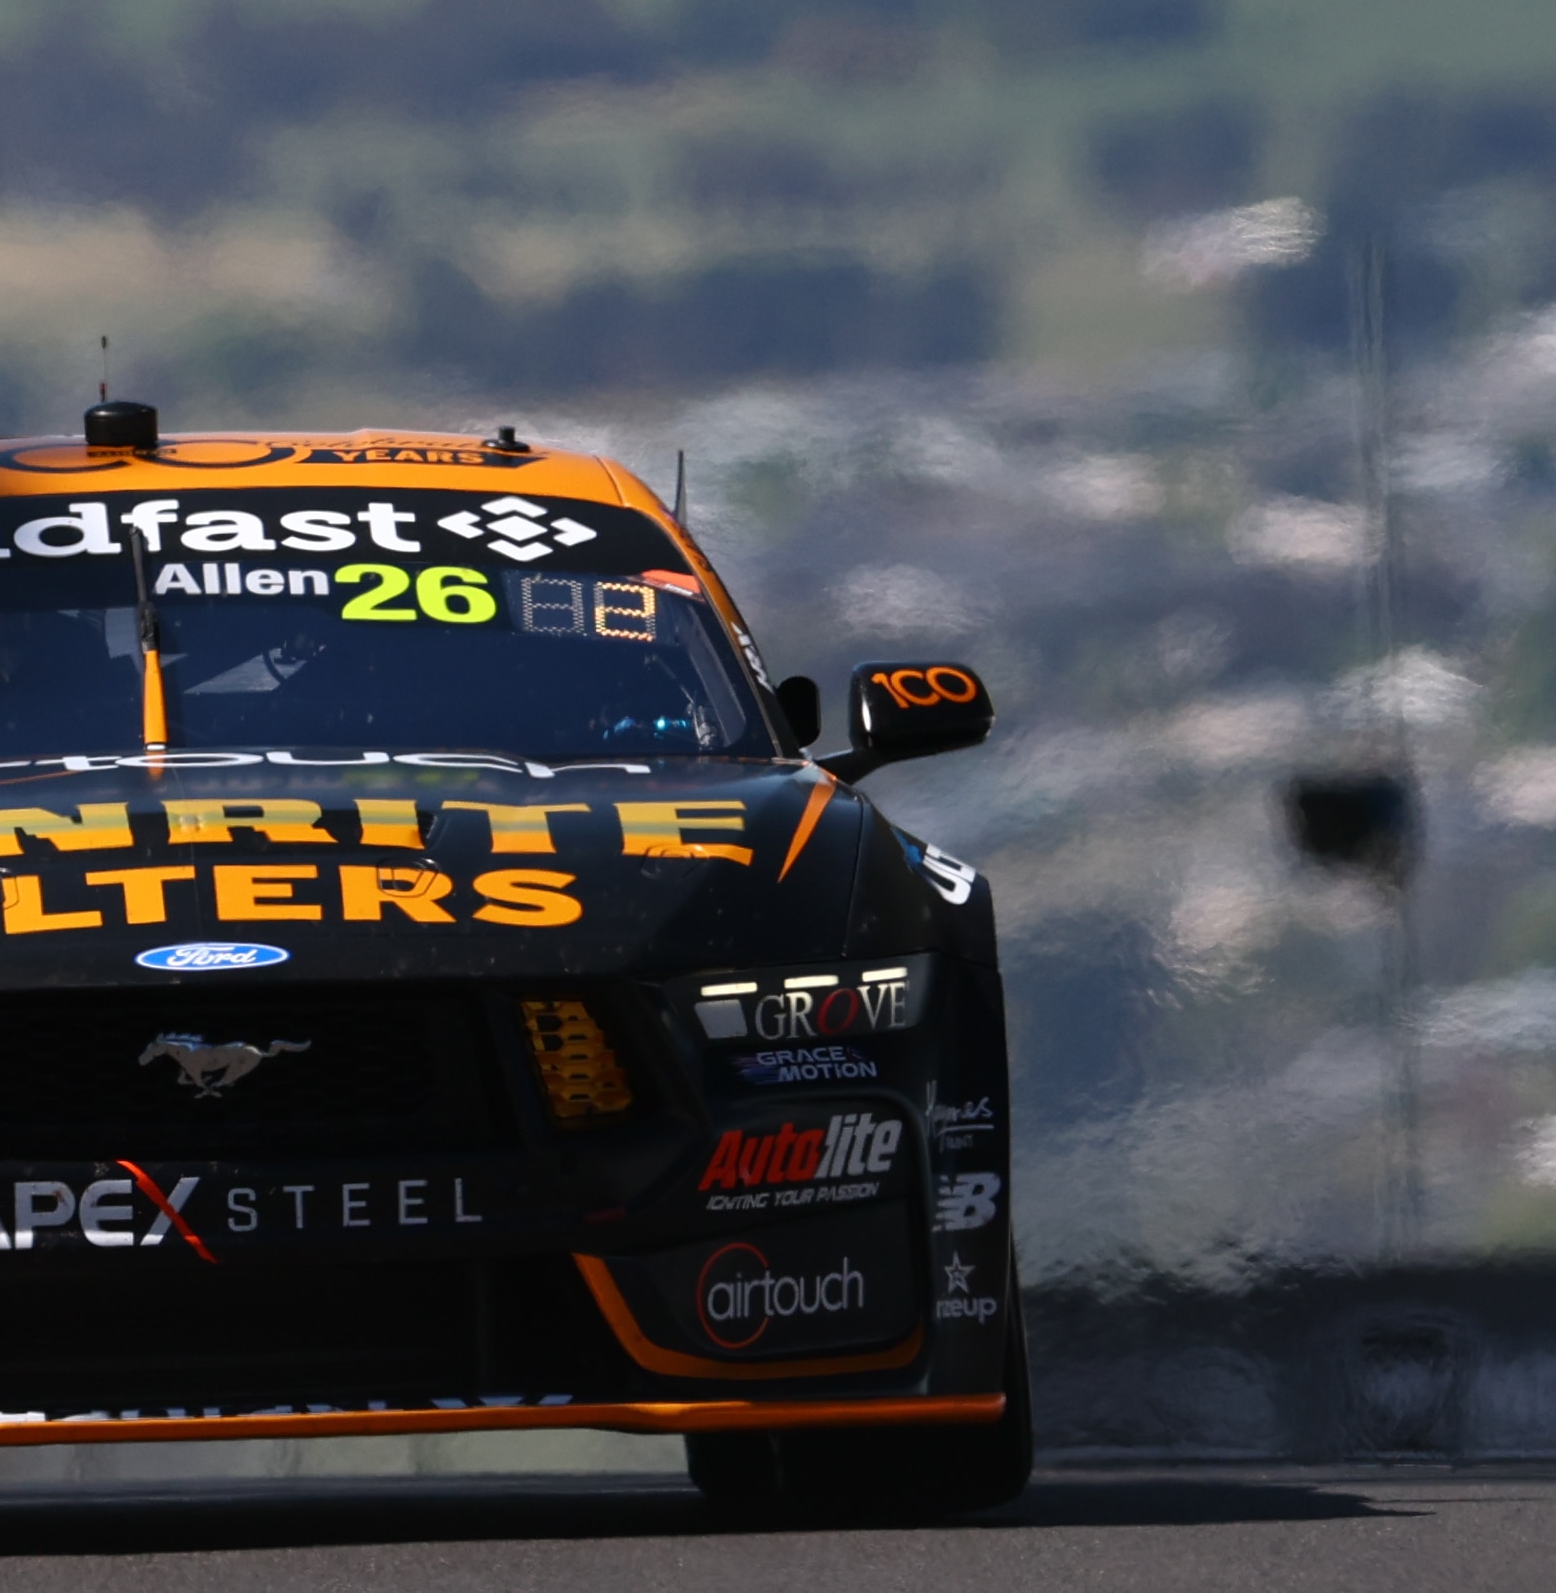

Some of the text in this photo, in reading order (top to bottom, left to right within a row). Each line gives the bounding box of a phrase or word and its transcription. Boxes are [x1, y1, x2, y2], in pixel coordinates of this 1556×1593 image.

[333, 448, 485, 464] YEARS
[155, 562, 329, 595] Allen
[334, 563, 497, 624] 26
[754, 981, 907, 1040] GROVE
[756, 1046, 847, 1066] GRACE
[697, 1113, 903, 1191] Autolite
[227, 1178, 482, 1232] STEEL
[774, 1188, 814, 1206] YOUR
[816, 1182, 880, 1202] PASSION
[707, 1256, 865, 1321] airtouch
